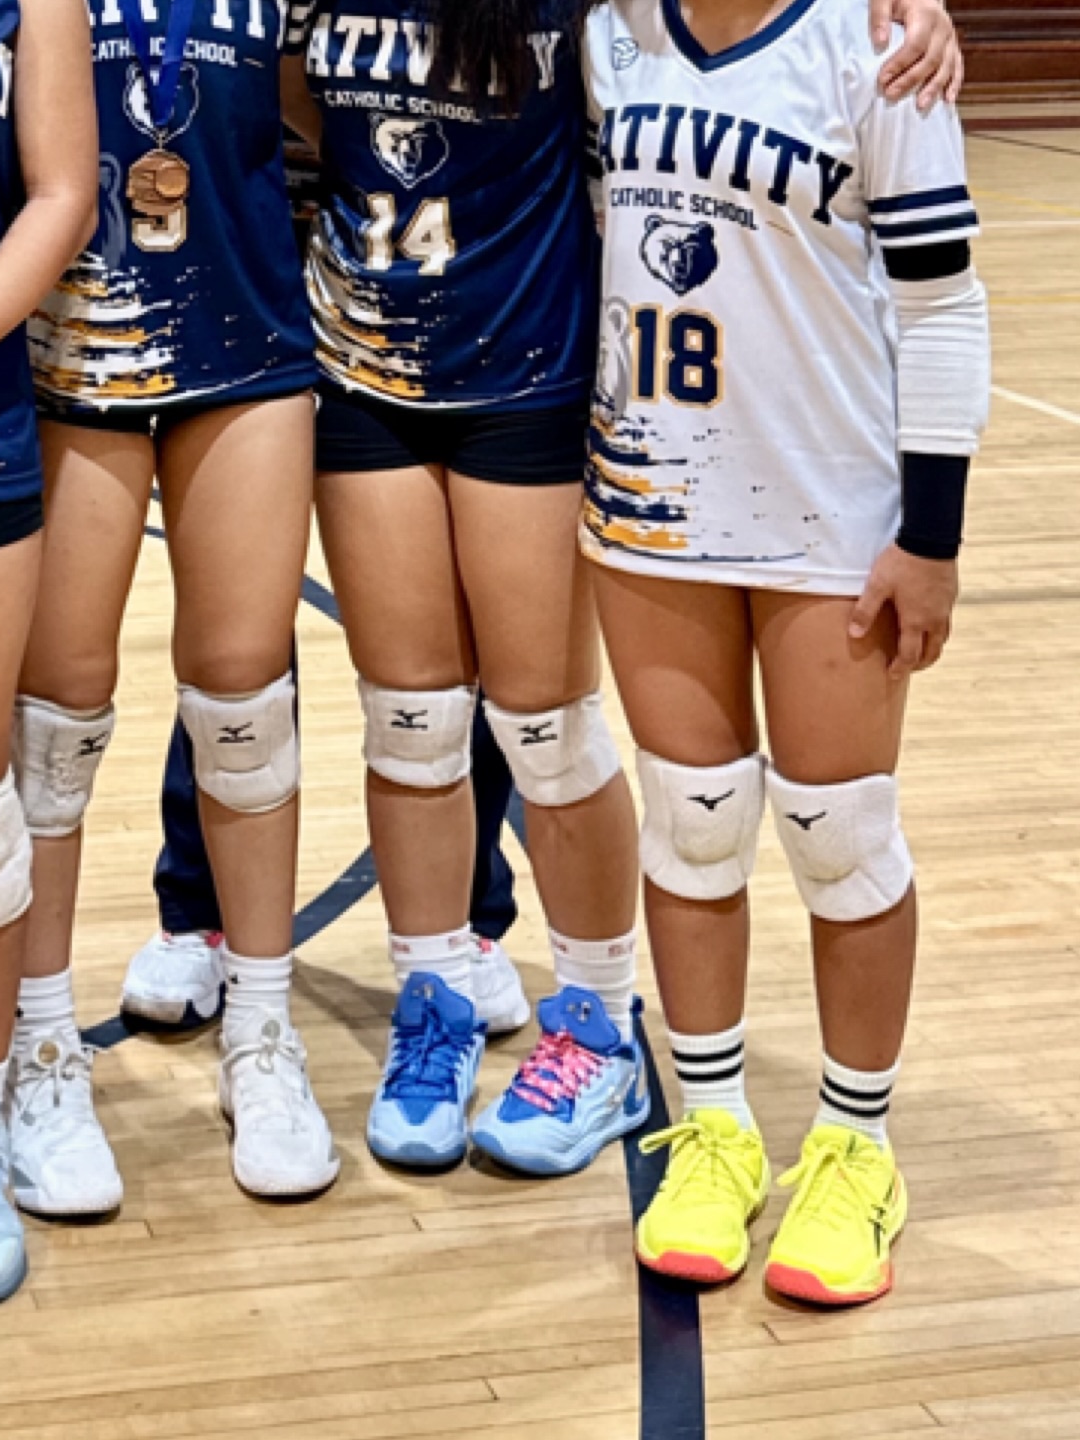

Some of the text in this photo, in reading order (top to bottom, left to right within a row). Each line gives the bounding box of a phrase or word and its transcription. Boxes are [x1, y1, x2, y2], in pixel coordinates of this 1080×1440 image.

[183, 39, 238, 68] CHOOL
[325, 91, 482, 123] CATHOLIC SCHOOL
[599, 103, 854, 225] ATIVITY
[365, 192, 456, 276] 14
[610, 187, 758, 231] CATHOLIC SCHOOL
[629, 302, 724, 409] 18
